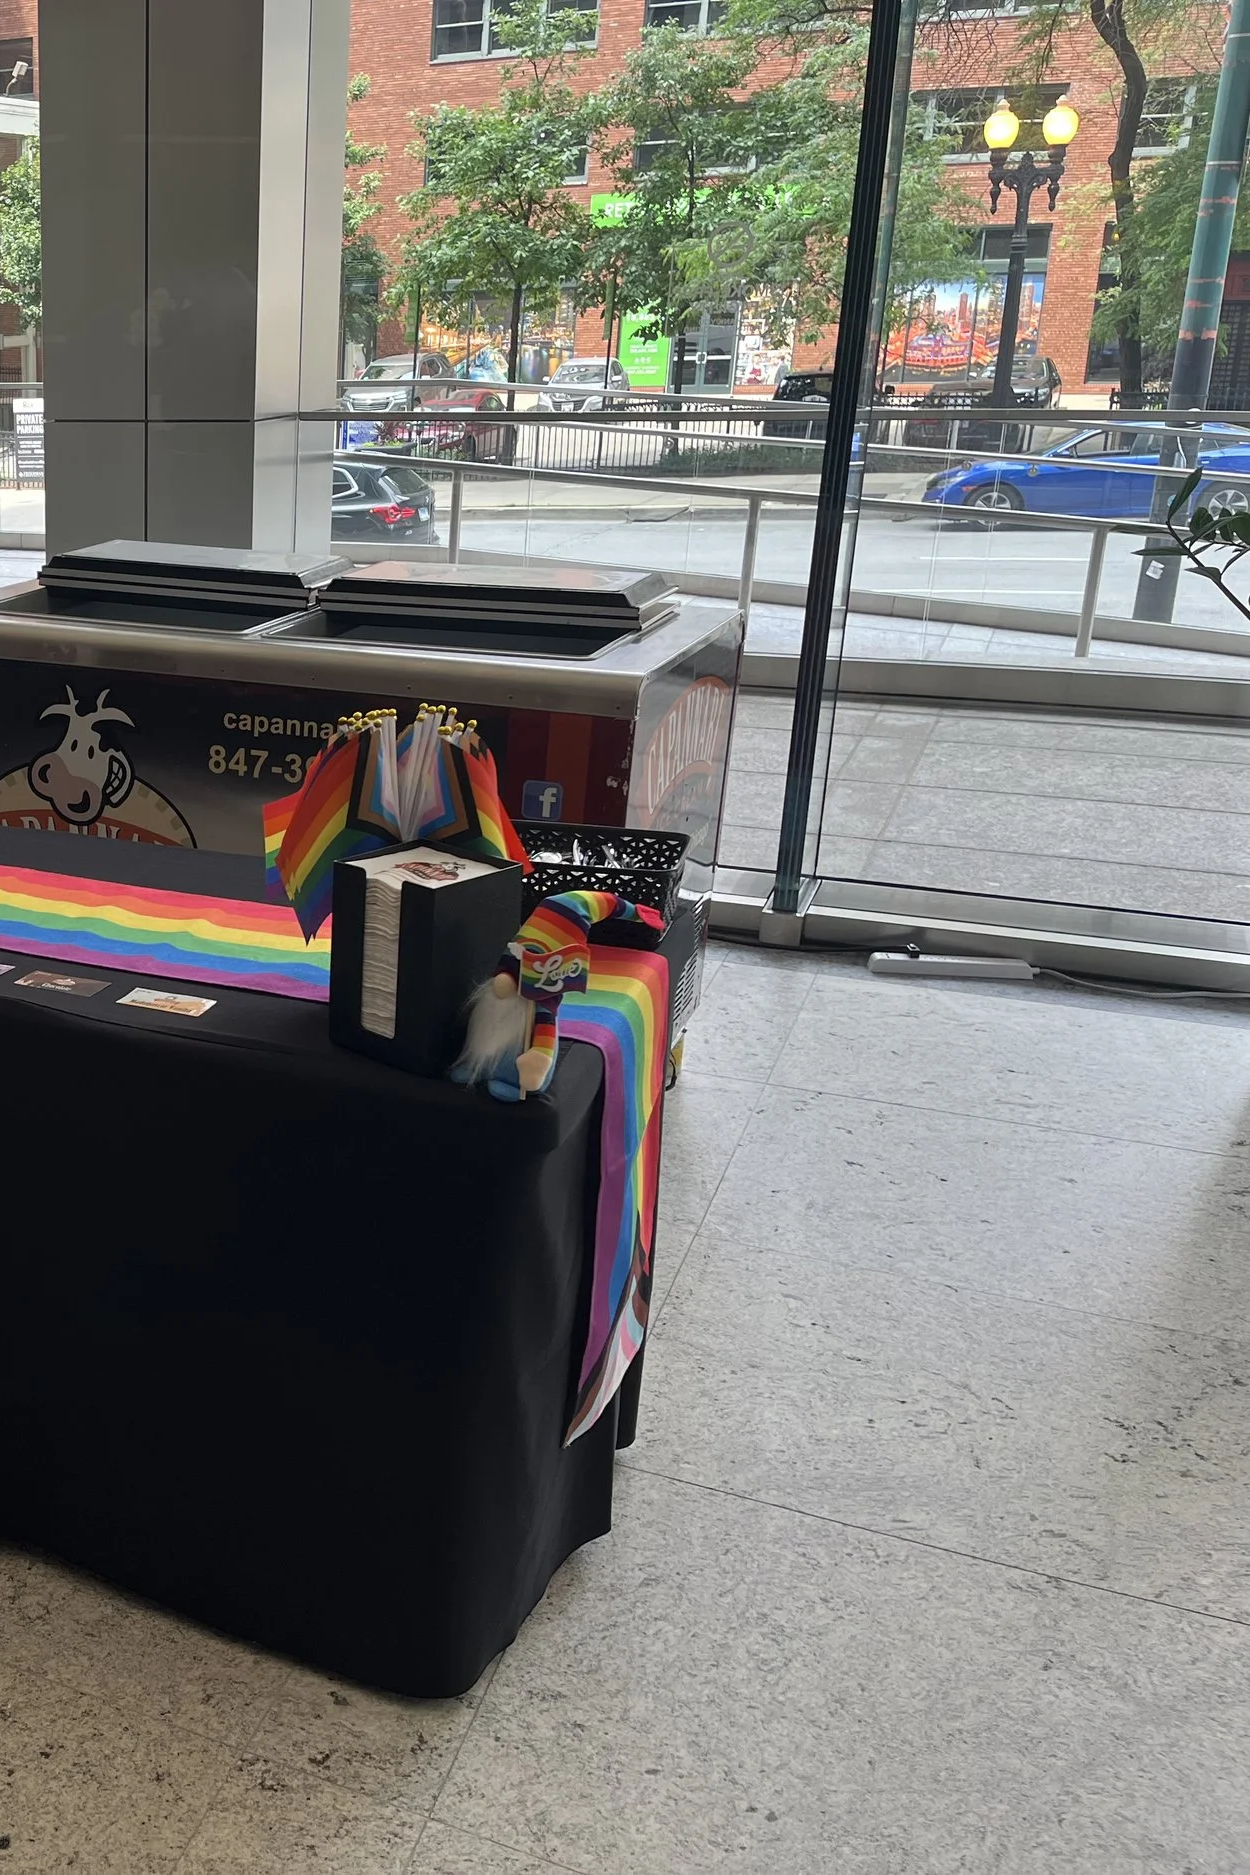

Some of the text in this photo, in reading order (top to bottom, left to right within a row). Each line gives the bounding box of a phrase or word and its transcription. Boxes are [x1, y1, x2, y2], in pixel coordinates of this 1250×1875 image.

[16, 413, 44, 425] PRIVATE
[16, 424, 44, 434] PARKING
[223, 712, 335, 740] capanna
[532, 954, 582, 993] Love
